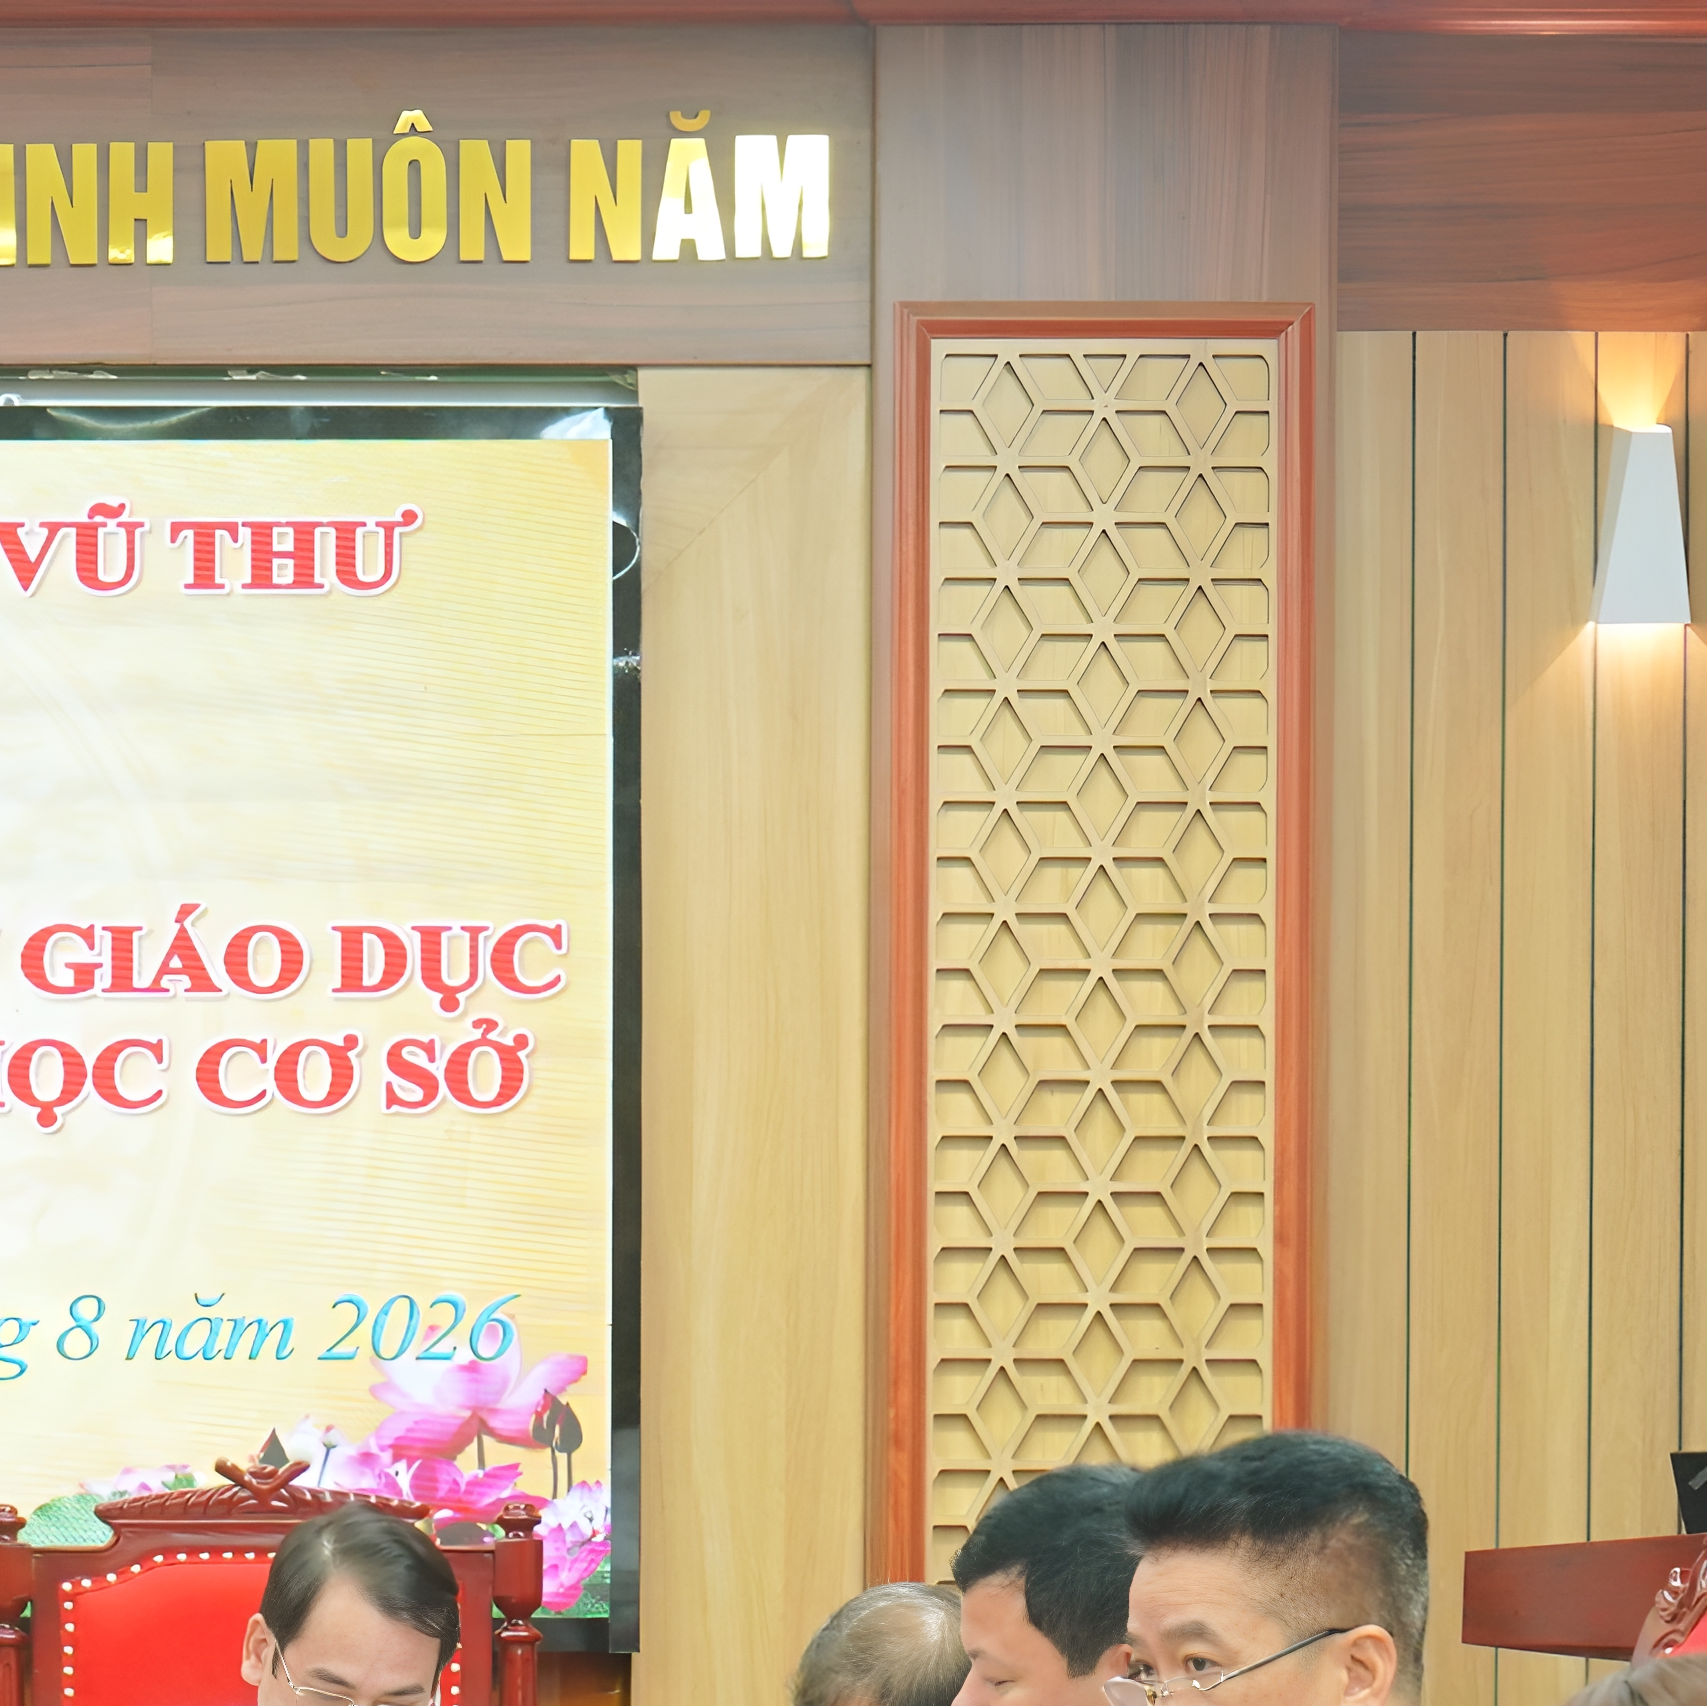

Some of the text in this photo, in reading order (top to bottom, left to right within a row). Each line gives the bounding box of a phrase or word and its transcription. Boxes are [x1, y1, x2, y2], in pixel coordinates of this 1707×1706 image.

[204, 109, 532, 264] MUÔN
[568, 109, 831, 263] NĂM
[170, 509, 419, 592] THƯ
[20, 903, 305, 997] GIÁO
[332, 923, 567, 1013] DỤC
[195, 1033, 359, 1111] CƠ
[386, 1017, 530, 1110] SỞ
[57, 1294, 106, 1361] 8
[126, 1293, 295, 1362] năm
[317, 1293, 522, 1362] 2026
